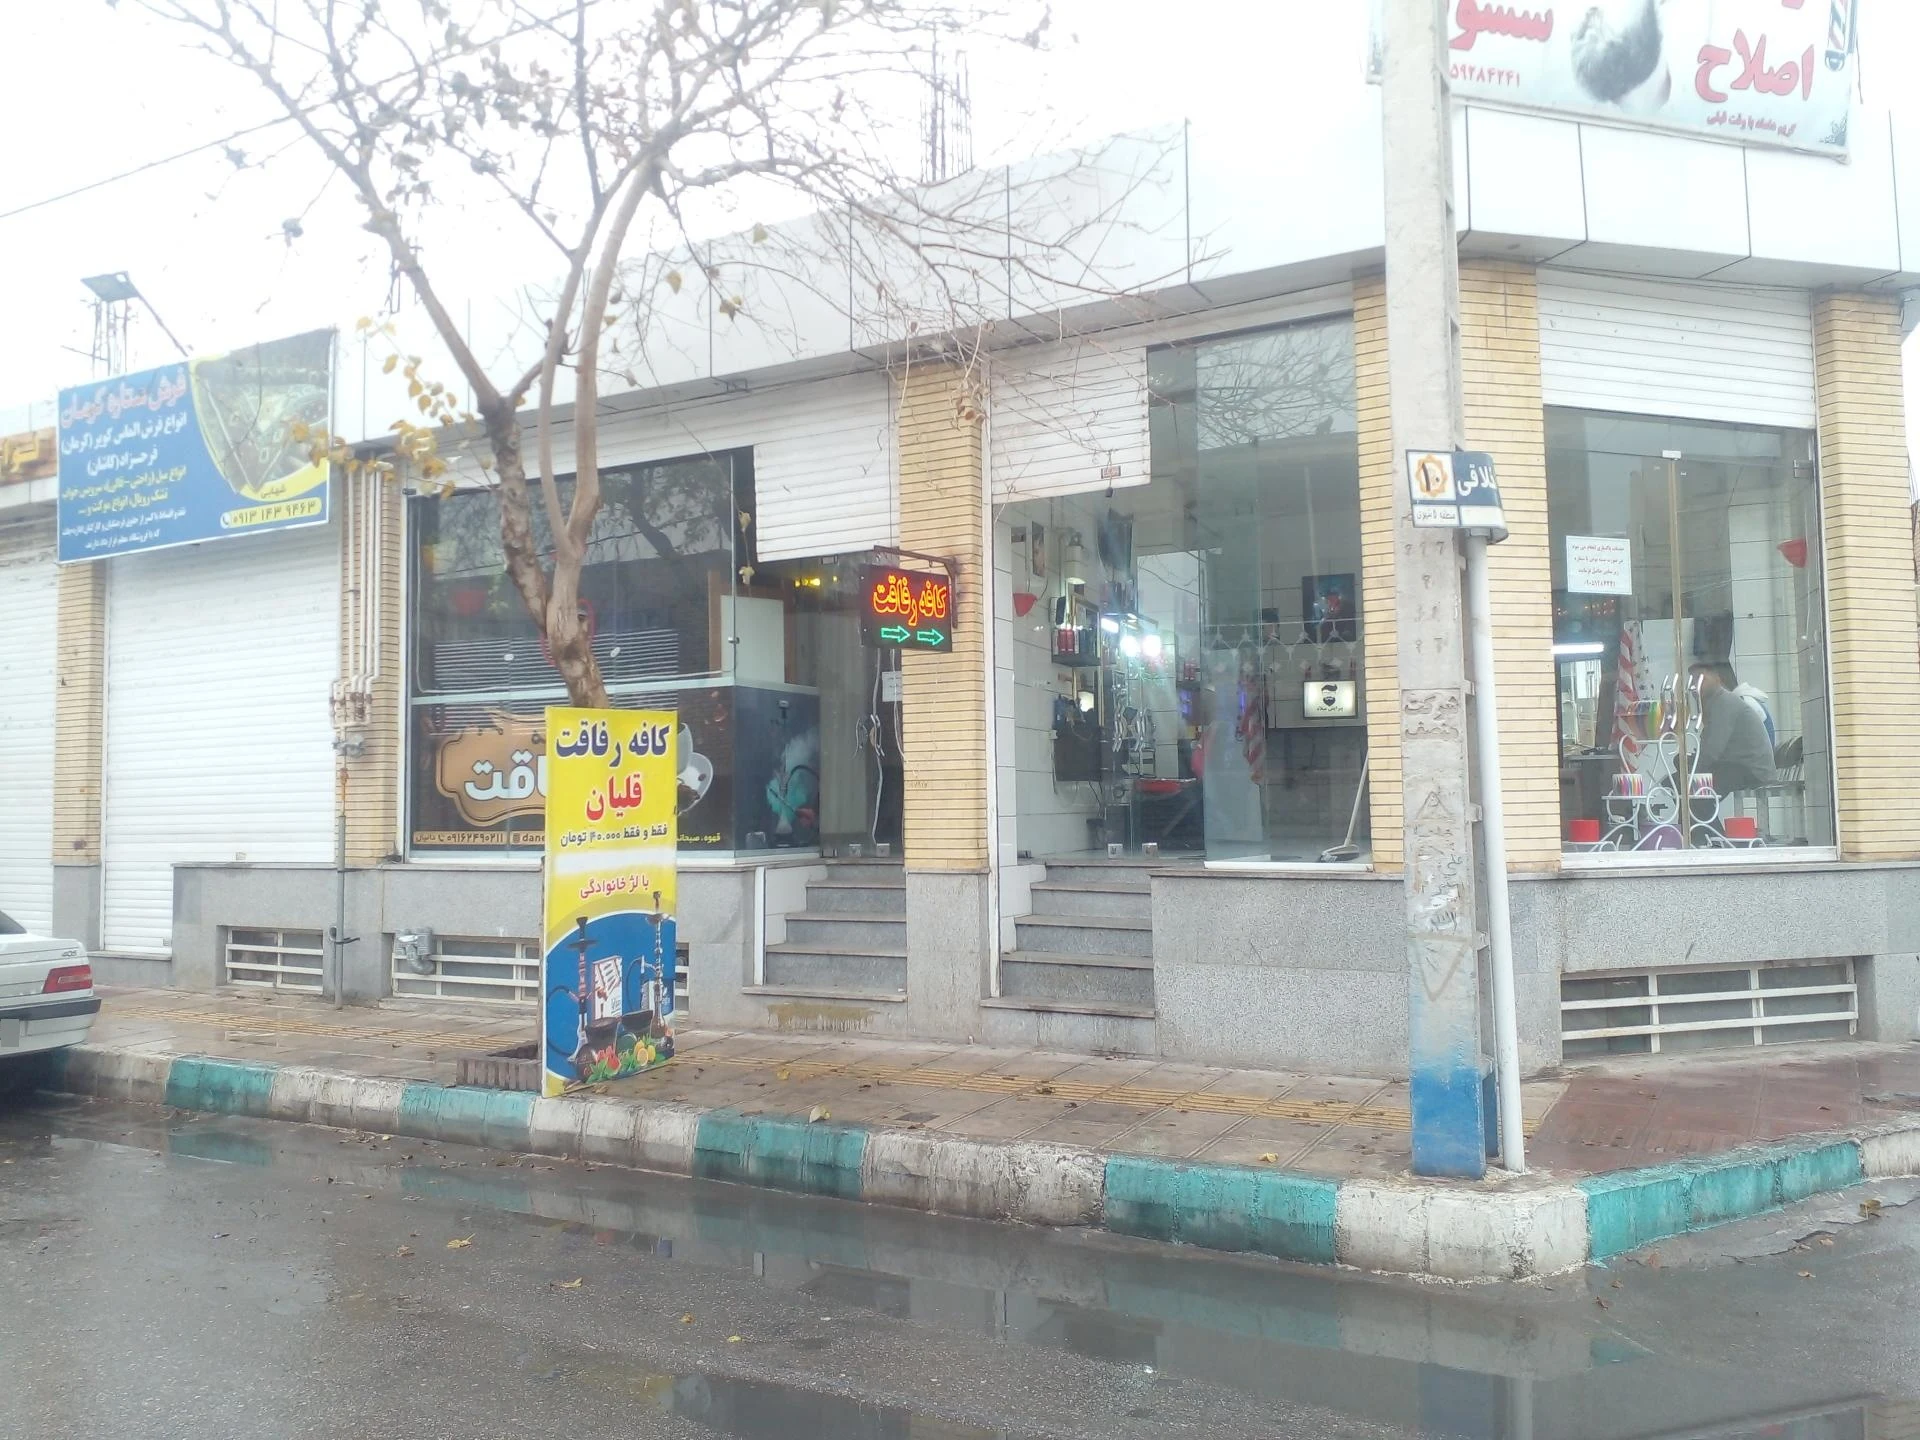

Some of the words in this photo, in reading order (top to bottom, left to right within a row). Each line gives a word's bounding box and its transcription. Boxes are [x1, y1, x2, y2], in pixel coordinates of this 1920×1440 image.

[1695, 27, 1815, 103] اصلاح
[166, 411, 188, 434] انواع
[232, 508, 257, 524] ۰۹۱۳
[873, 574, 918, 627] رفاقت
[919, 579, 947, 619] کافه
[556, 720, 622, 768] رفاقت
[628, 721, 670, 756] کافه
[464, 748, 546, 801] اقت
[586, 773, 643, 821] قلیان
[560, 830, 587, 847] تومان
[623, 825, 641, 839] فقط
[643, 829, 649, 841] و
[650, 823, 668, 837] فقط
[580, 877, 626, 899] خانوادگی
[629, 874, 639, 893] لژ
[641, 874, 650, 891] با
